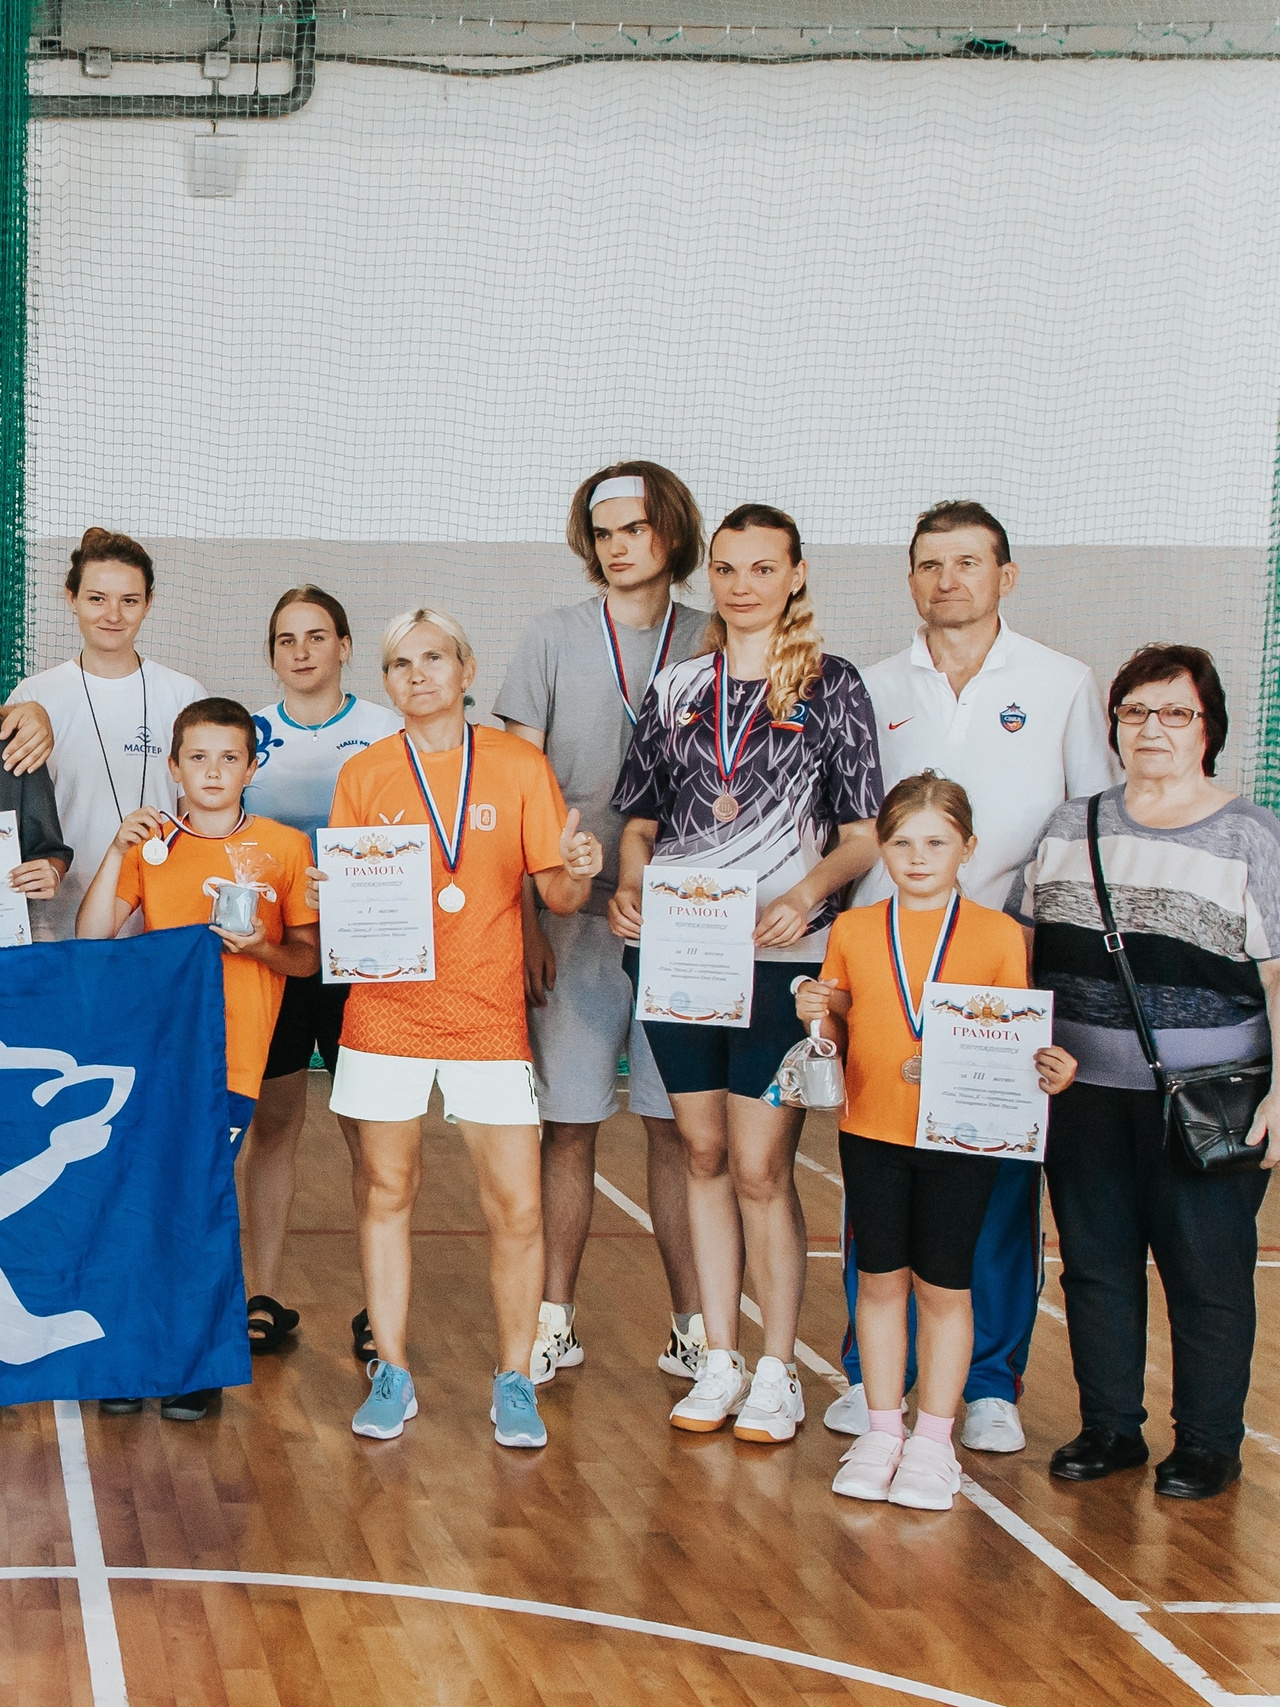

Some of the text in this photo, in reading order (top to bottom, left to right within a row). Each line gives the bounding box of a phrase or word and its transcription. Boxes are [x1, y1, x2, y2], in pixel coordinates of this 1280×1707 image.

[123, 744, 163, 754] МАСТЕР
[468, 803, 497, 832] 10
[344, 866, 404, 876] ГРАМОТА
[669, 906, 729, 918] ГРАМОТА
[953, 1026, 1020, 1042] ГРАМОТА
